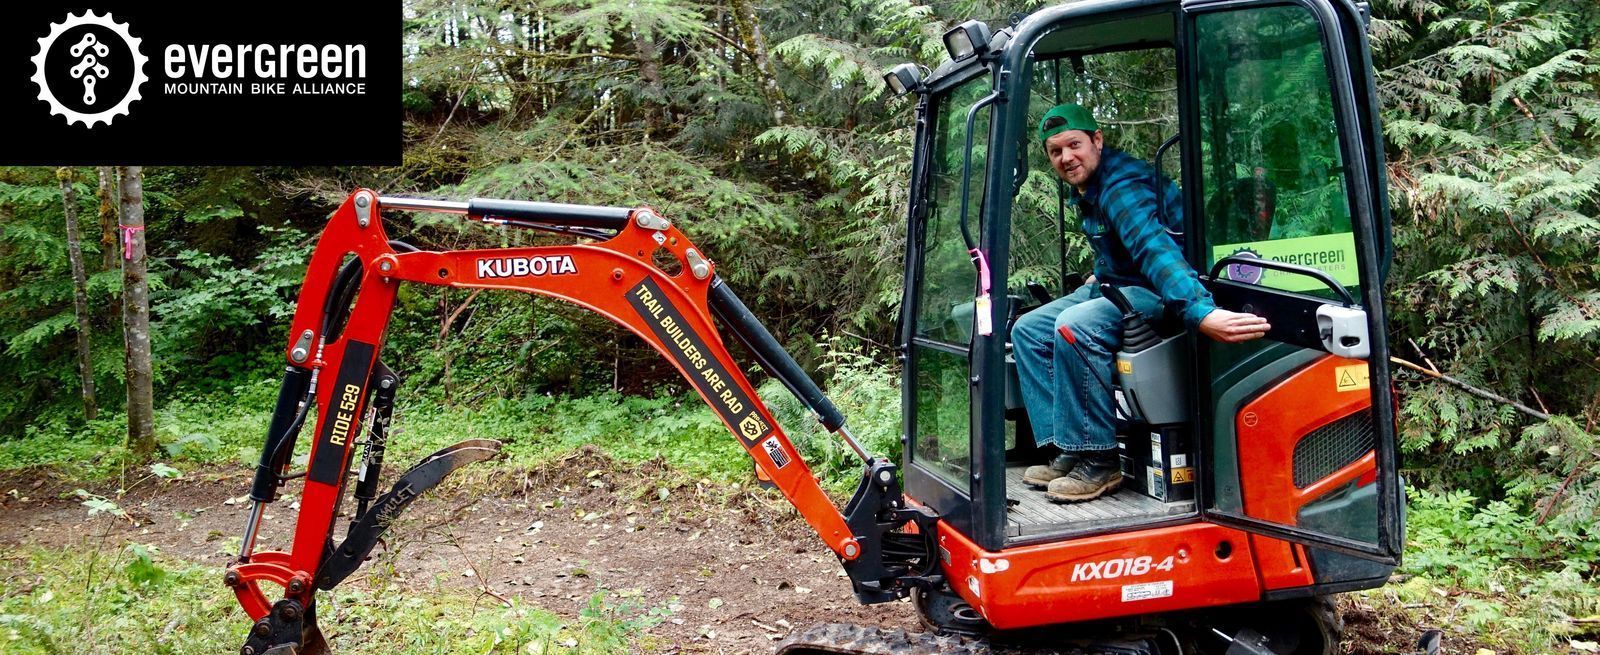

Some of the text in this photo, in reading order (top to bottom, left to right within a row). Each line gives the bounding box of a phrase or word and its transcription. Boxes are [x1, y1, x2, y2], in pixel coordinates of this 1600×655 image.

[477, 254, 577, 278] KUBOTA
[636, 284, 743, 415] TRAIL BUILDERS ARE RAD
[329, 383, 361, 446] RIDE 529
[743, 420, 759, 436] 529
[1070, 555, 1175, 582] KX018-4
